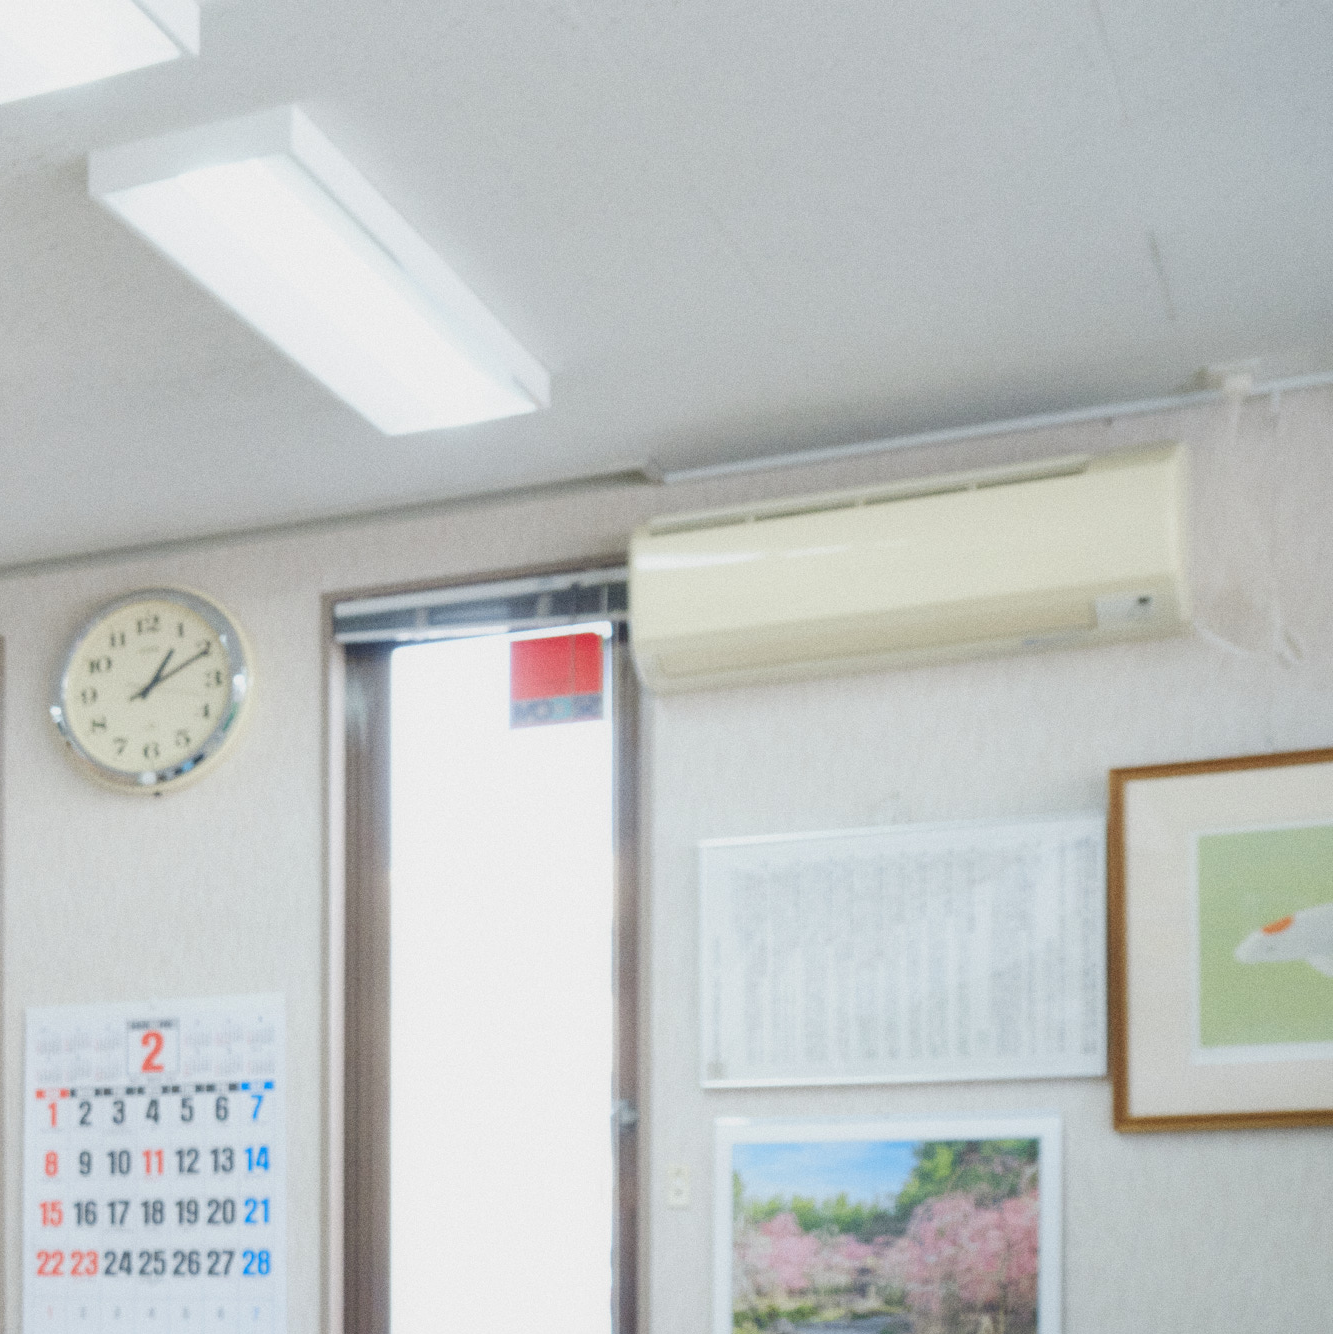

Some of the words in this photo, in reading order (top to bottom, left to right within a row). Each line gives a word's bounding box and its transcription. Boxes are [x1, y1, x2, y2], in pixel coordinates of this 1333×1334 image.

[141, 1031, 164, 1072] 2
[48, 1101, 57, 1127] 1
[78, 1099, 92, 1127] 2
[112, 1099, 126, 1126] 3
[145, 1098, 160, 1124] 4
[180, 1096, 195, 1123] 5
[214, 1095, 229, 1122] 6
[251, 1093, 264, 1120] 7
[44, 1151, 59, 1177] 8
[78, 1150, 93, 1177] 9
[107, 1149, 132, 1176] 10
[142, 1149, 164, 1175] 11
[175, 1147, 200, 1175] 12
[210, 1146, 235, 1174] 13
[245, 1146, 270, 1171] 14
[39, 1200, 64, 1227] 15
[73, 1200, 98, 1226] 16
[107, 1199, 131, 1226] 17
[141, 1199, 165, 1226] 18
[175, 1199, 200, 1225] 19
[206, 1198, 236, 1225] 20
[244, 1197, 270, 1224] 21
[36, 1250, 65, 1277] 22
[70, 1250, 99, 1277] 23
[104, 1250, 133, 1276] 24
[138, 1249, 167, 1277] 25
[172, 1249, 201, 1276] 26
[206, 1249, 235, 1276] 27
[242, 1249, 271, 1276] 28
[46, 1306, 54, 1319] 1
[79, 1306, 87, 1320] 2
[113, 1306, 121, 1320] 3
[148, 1306, 156, 1320] 4
[182, 1306, 190, 1320] 5
[217, 1306, 225, 1320] 6
[253, 1306, 260, 1320] 7
